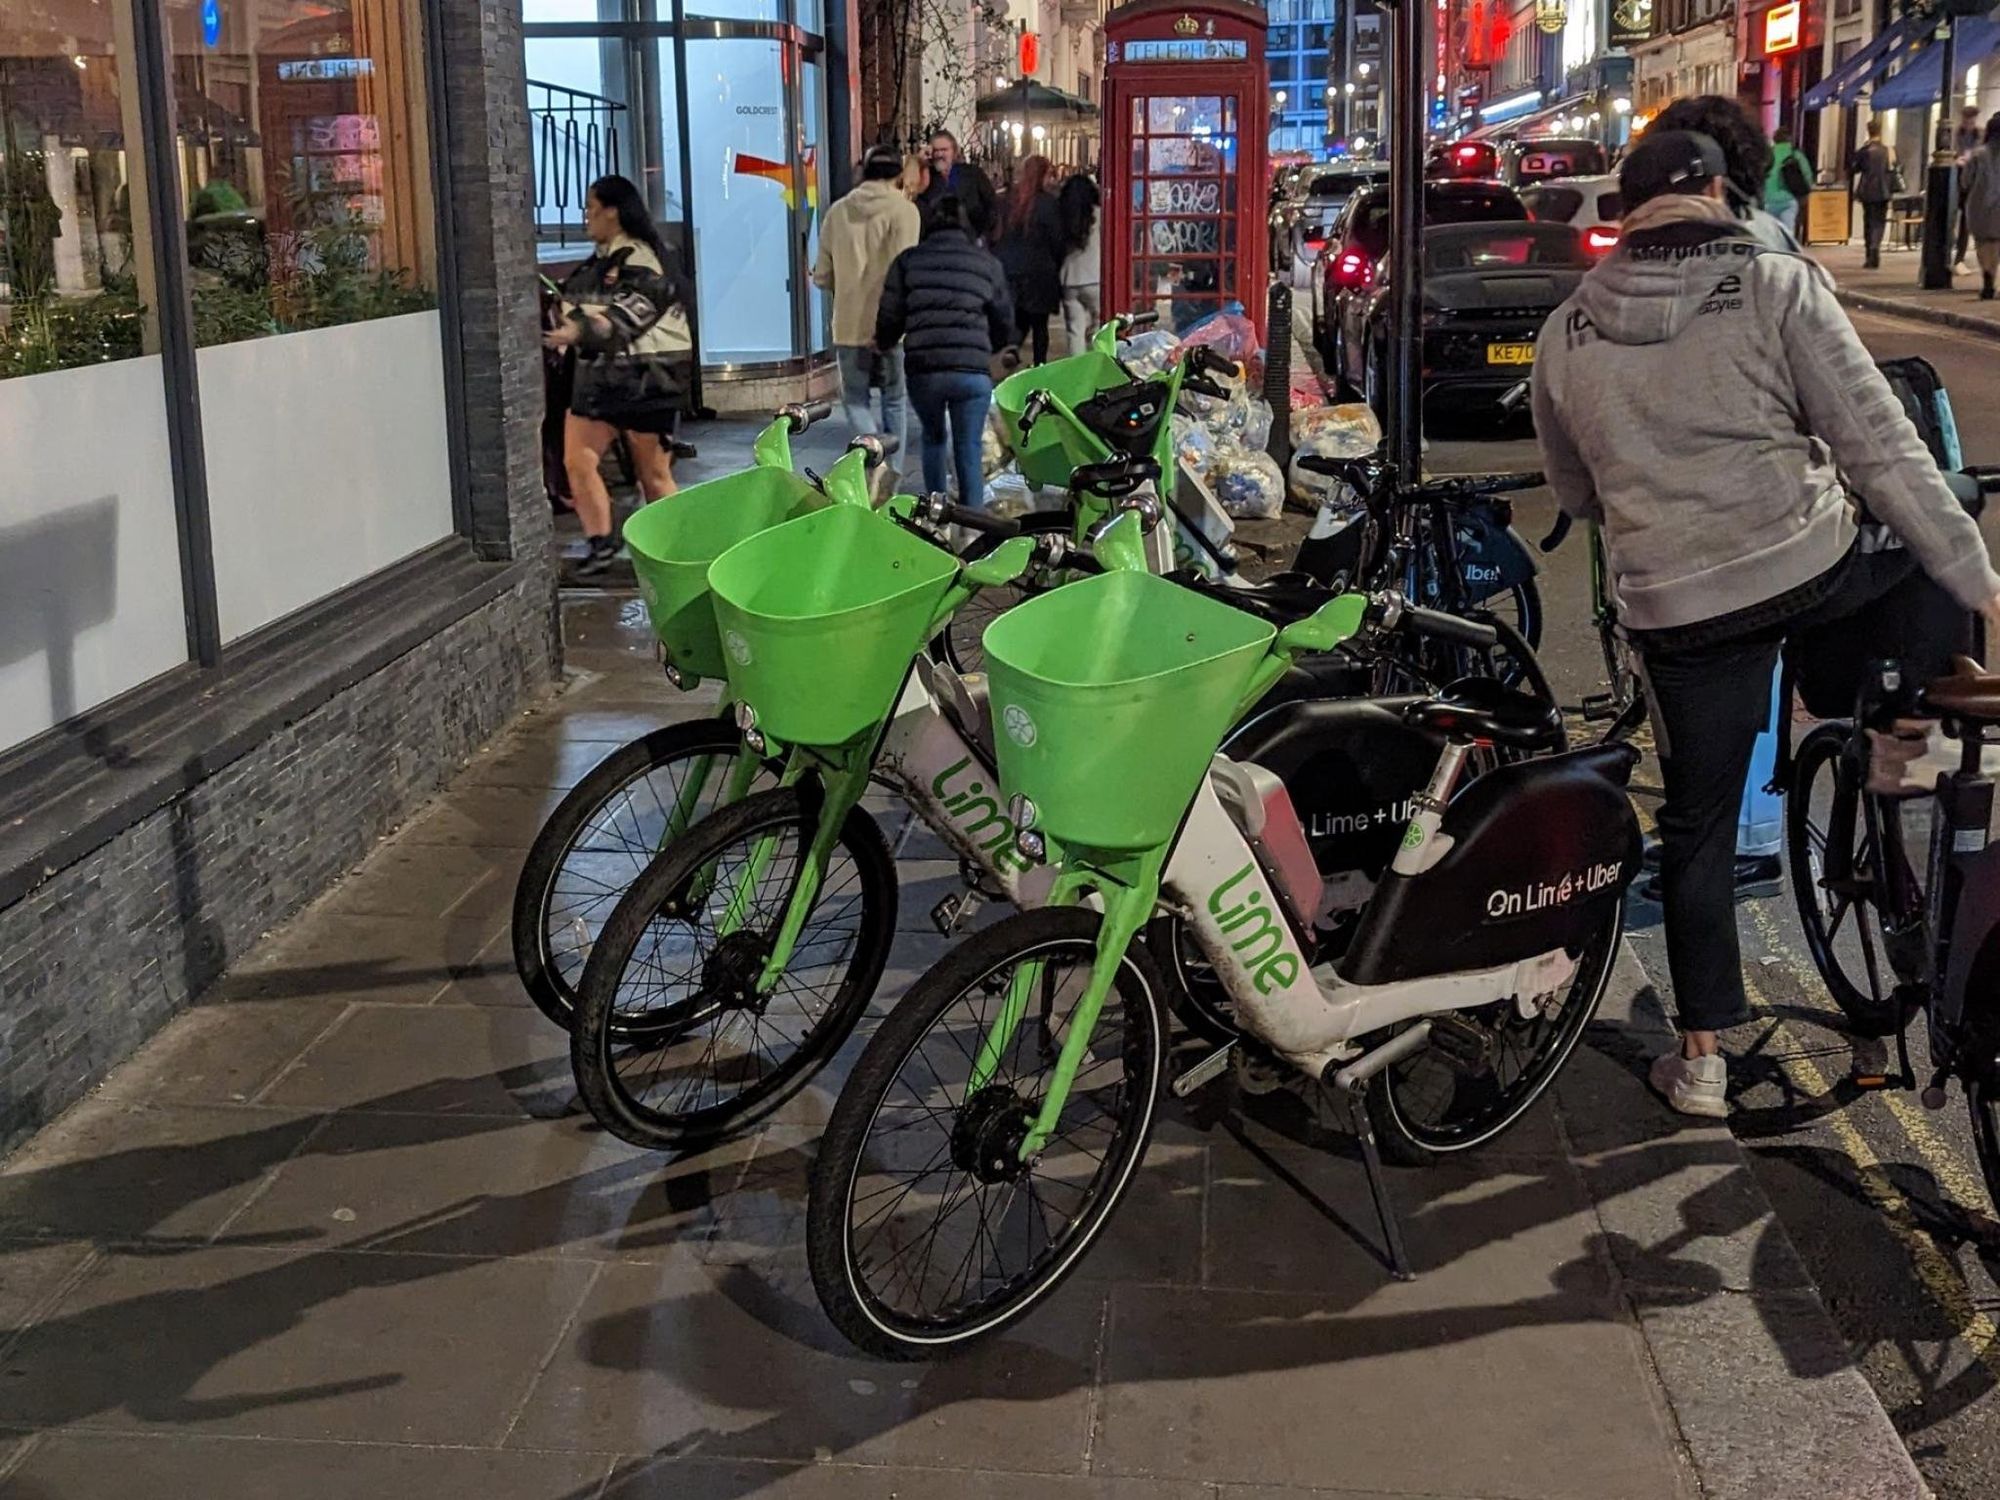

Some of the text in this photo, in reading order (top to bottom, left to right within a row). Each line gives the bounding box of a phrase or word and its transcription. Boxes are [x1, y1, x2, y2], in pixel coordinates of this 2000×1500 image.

[1131, 42, 1241, 60] TELEPHONE
[736, 106, 778, 115] GOLDCREST
[932, 755, 1034, 876] Lime
[1311, 813, 1369, 836] Lime
[1487, 889, 1521, 917] On
[1526, 871, 1573, 911] Lime
[1587, 861, 1622, 892] Uber
[1208, 861, 1299, 996] Lime
